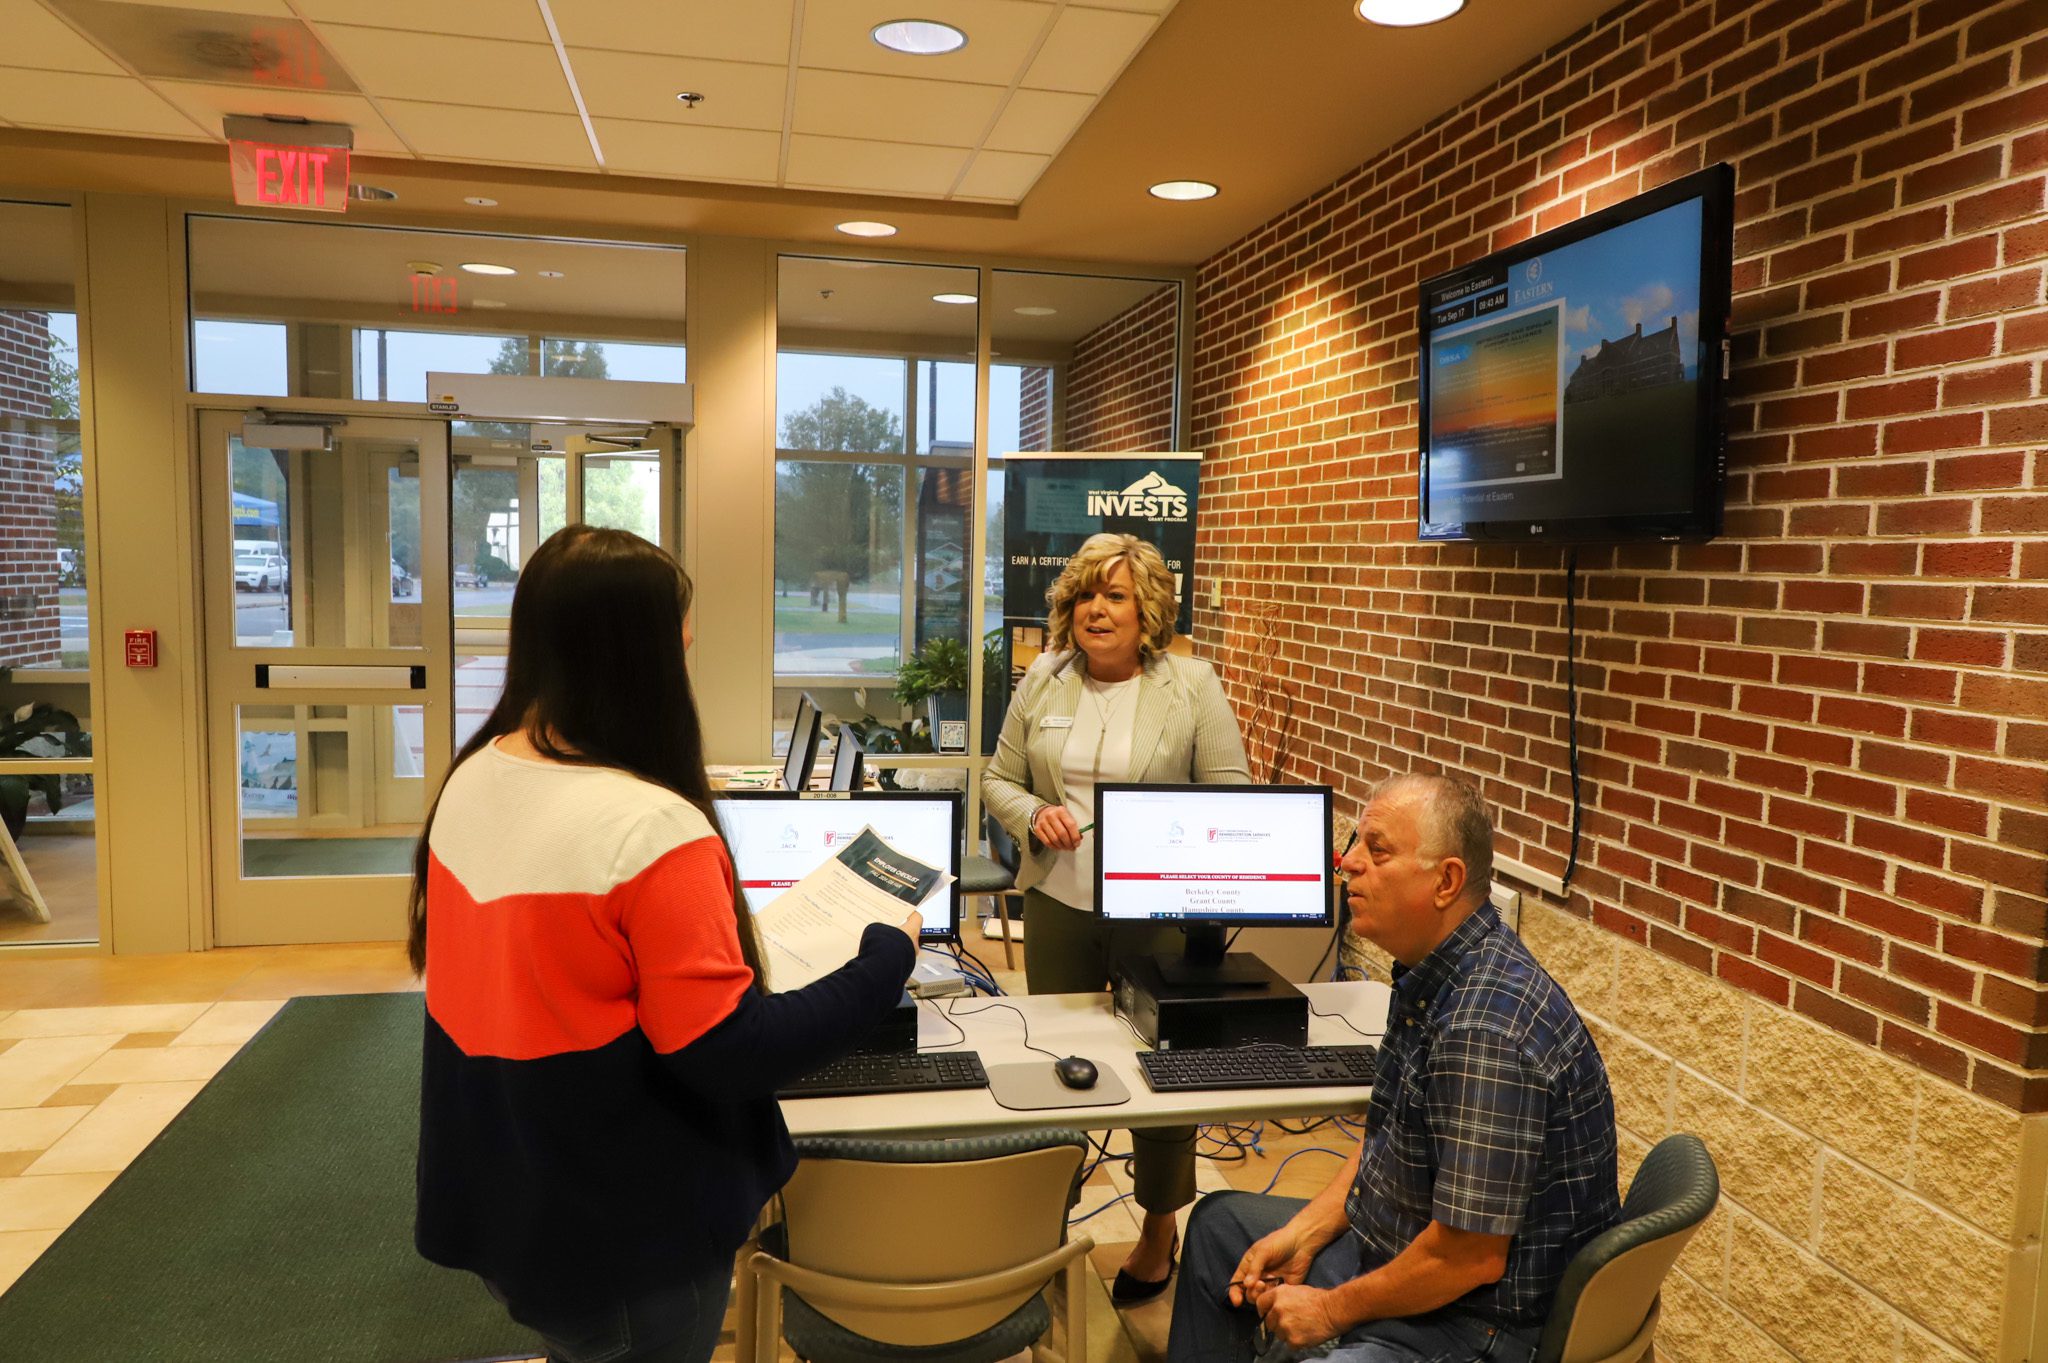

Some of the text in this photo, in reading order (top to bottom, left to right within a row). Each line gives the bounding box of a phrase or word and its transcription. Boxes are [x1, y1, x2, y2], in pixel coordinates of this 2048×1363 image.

[255, 148, 329, 206] EXIT
[1441, 276, 1494, 302] Welcome to Eastern!
[1514, 281, 1553, 304] EASTERN
[1495, 294, 1505, 306] AM
[1438, 308, 1465, 323] Tue Sep 17
[431, 403, 458, 411] STANLEY
[1087, 495, 1188, 518] INVESTS
[1011, 555, 1072, 567] EARN A CERTIFIC
[1167, 560, 1181, 570] FOR
[1185, 888, 1241, 896] Berkeley County
